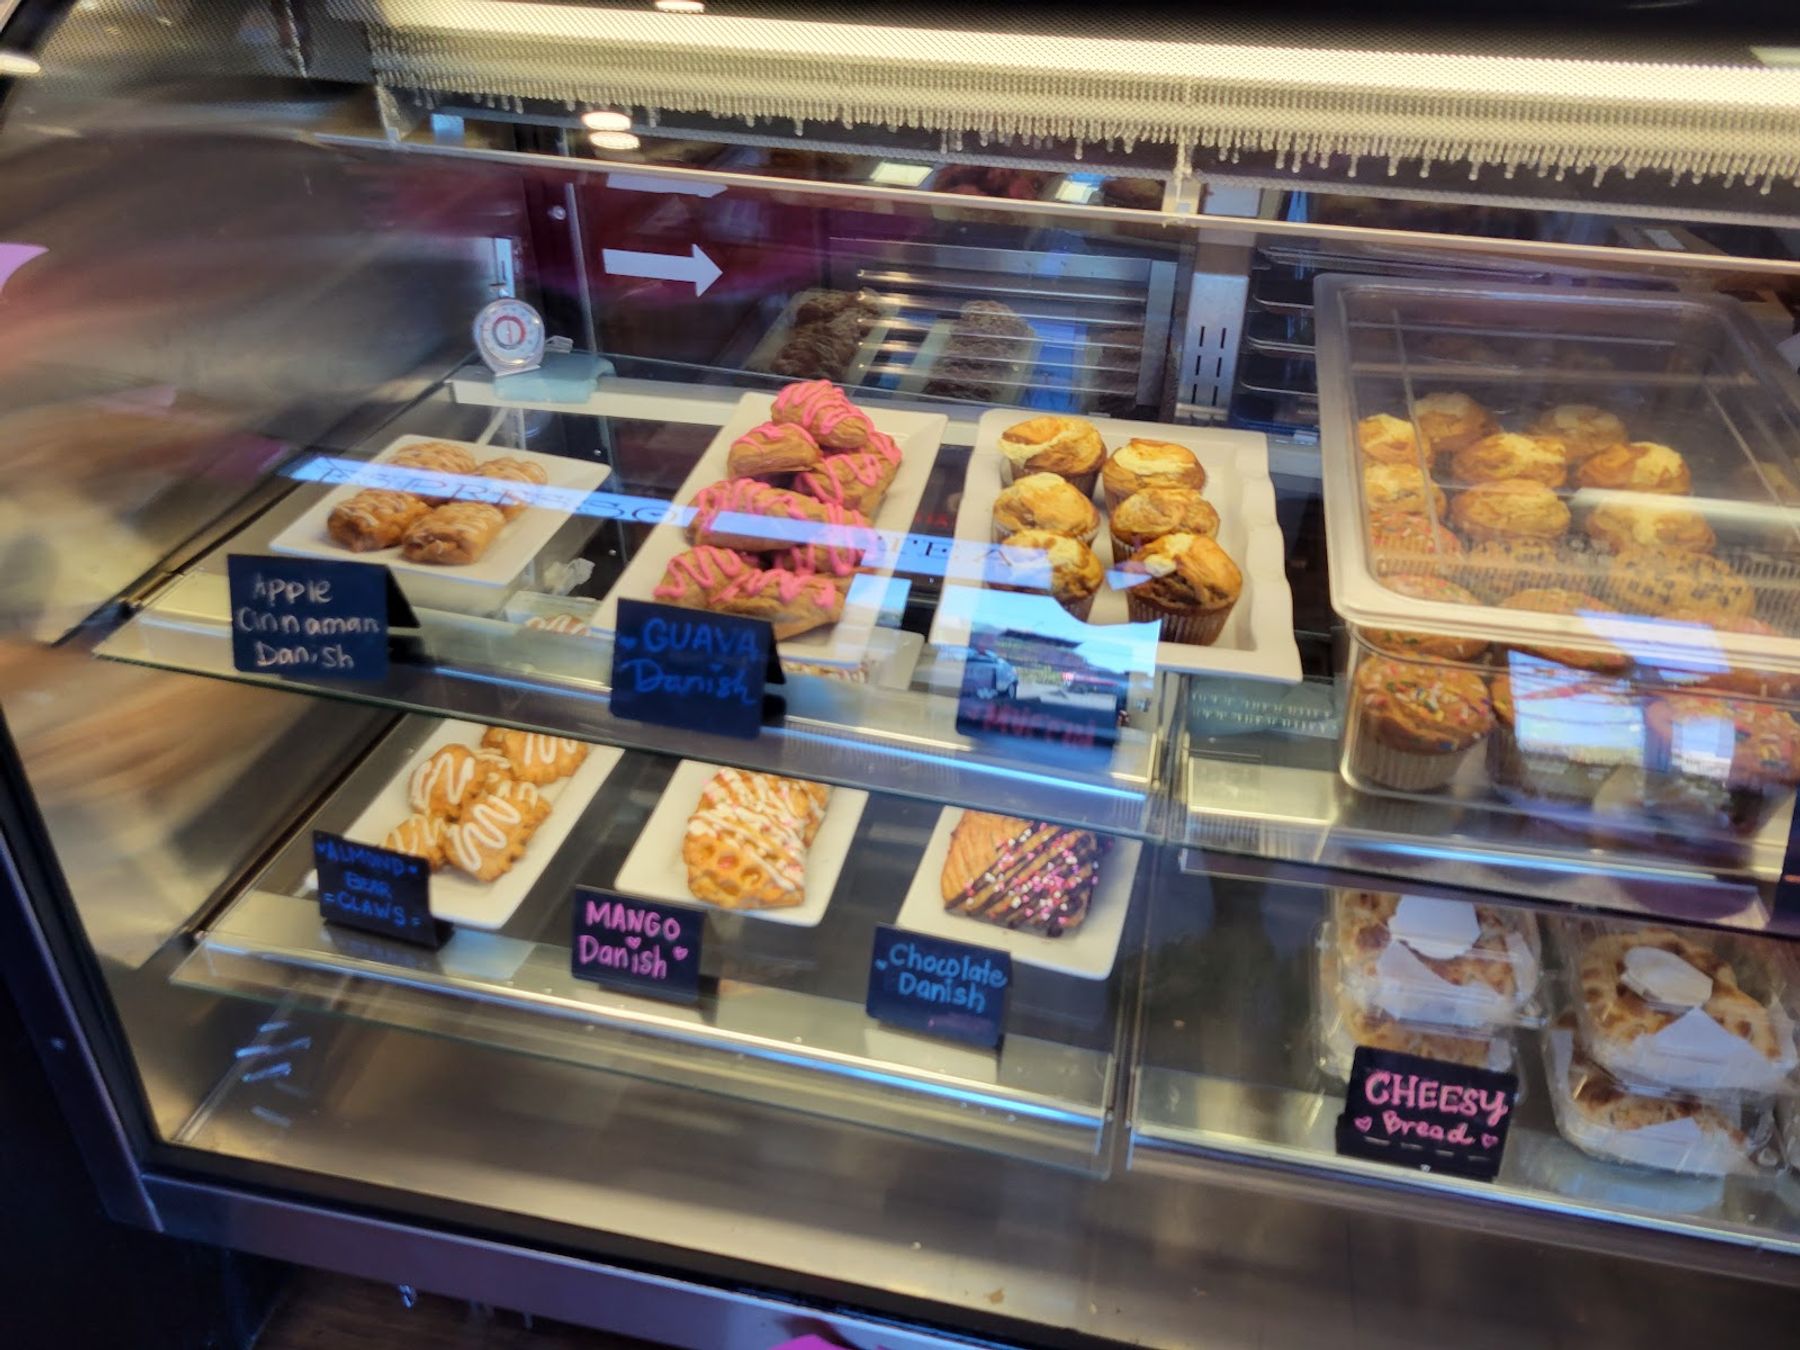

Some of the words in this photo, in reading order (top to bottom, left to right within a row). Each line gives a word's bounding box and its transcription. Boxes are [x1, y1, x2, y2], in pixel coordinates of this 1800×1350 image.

[254, 573, 332, 606] Apple
[255, 641, 354, 668] Danish
[643, 617, 759, 661] GUAVA
[621, 657, 757, 704] Danish
[327, 841, 404, 877] ALMOND
[338, 891, 405, 927] CLAWS
[586, 900, 681, 941] MANGO
[579, 934, 667, 979] Danish
[889, 943, 1008, 988] Chocolate
[898, 971, 986, 1013] Danish
[1382, 1110, 1476, 1146] Bread
